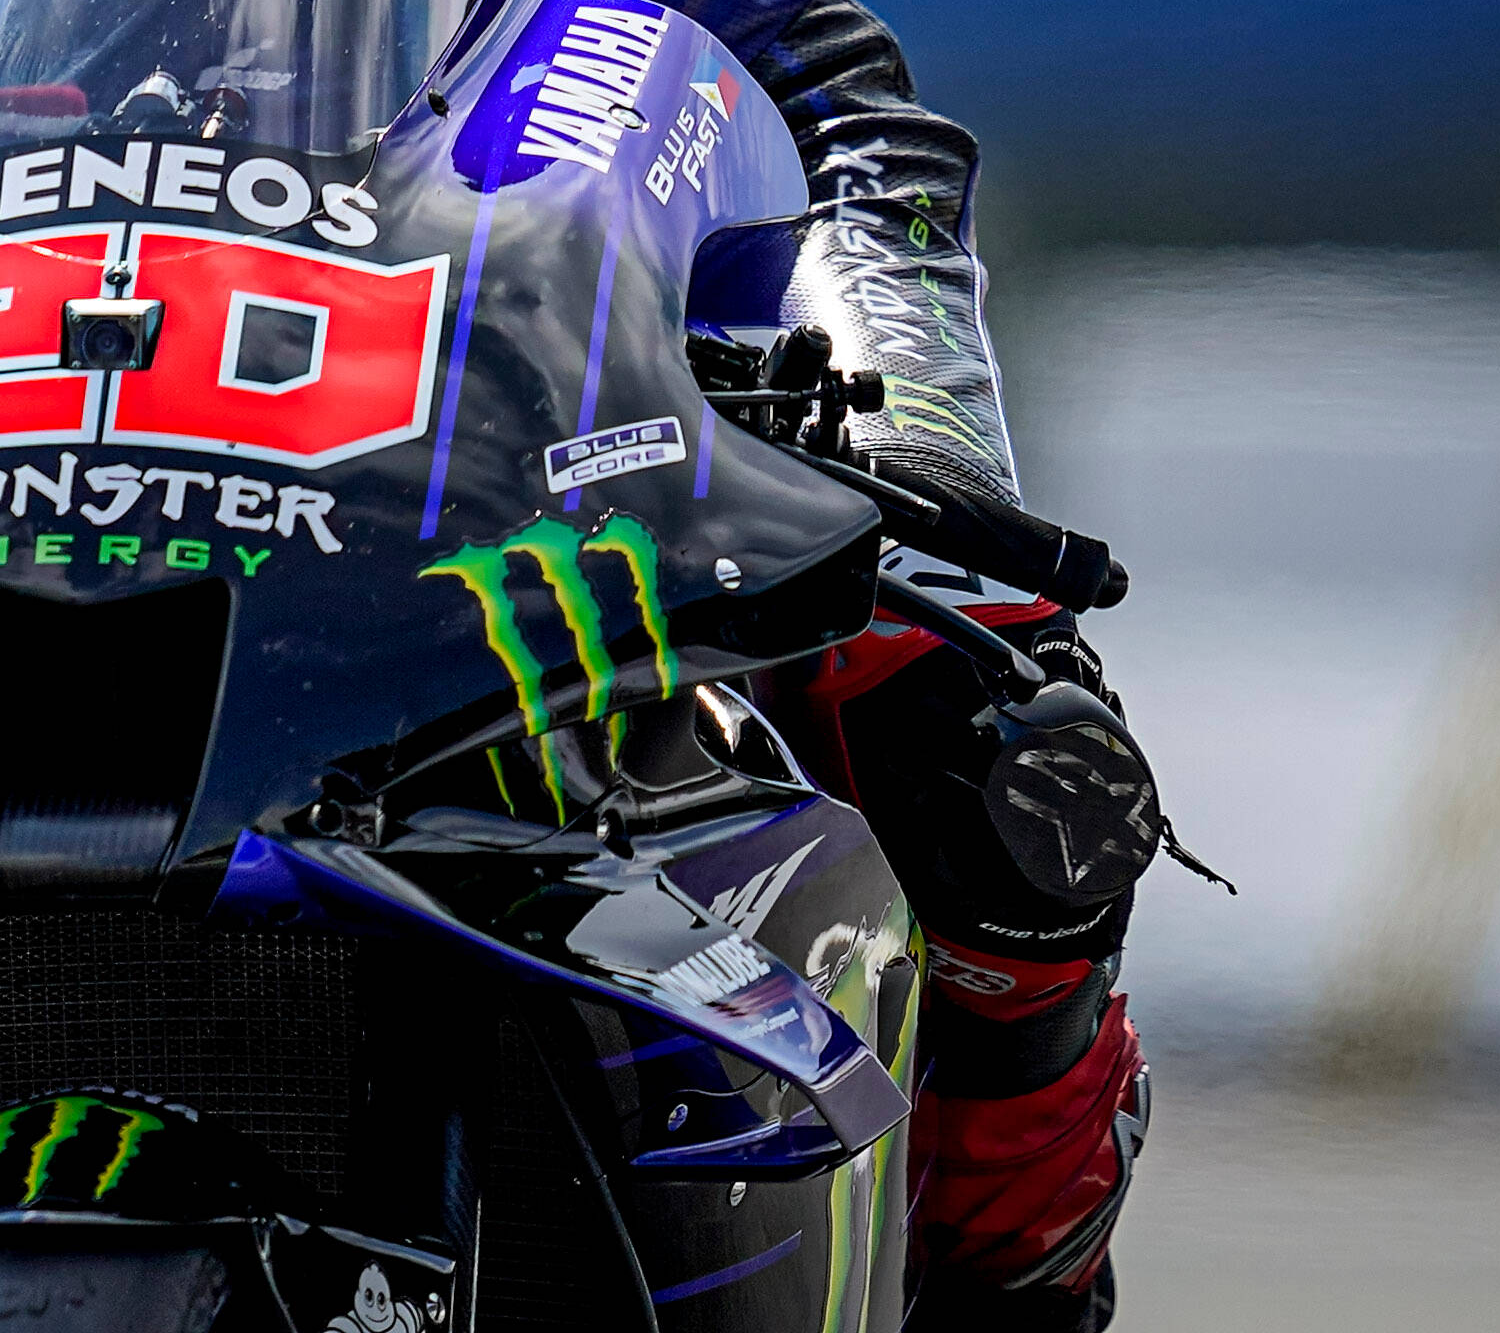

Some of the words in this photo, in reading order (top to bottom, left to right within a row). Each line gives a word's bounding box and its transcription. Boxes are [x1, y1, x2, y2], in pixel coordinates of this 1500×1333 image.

[516, 6, 670, 175] YAMAHA
[681, 106, 722, 193] FAST
[567, 425, 663, 462] BLUE
[571, 444, 666, 481] CORE
[1035, 639, 1070, 655] one
[978, 922, 1034, 939] one
